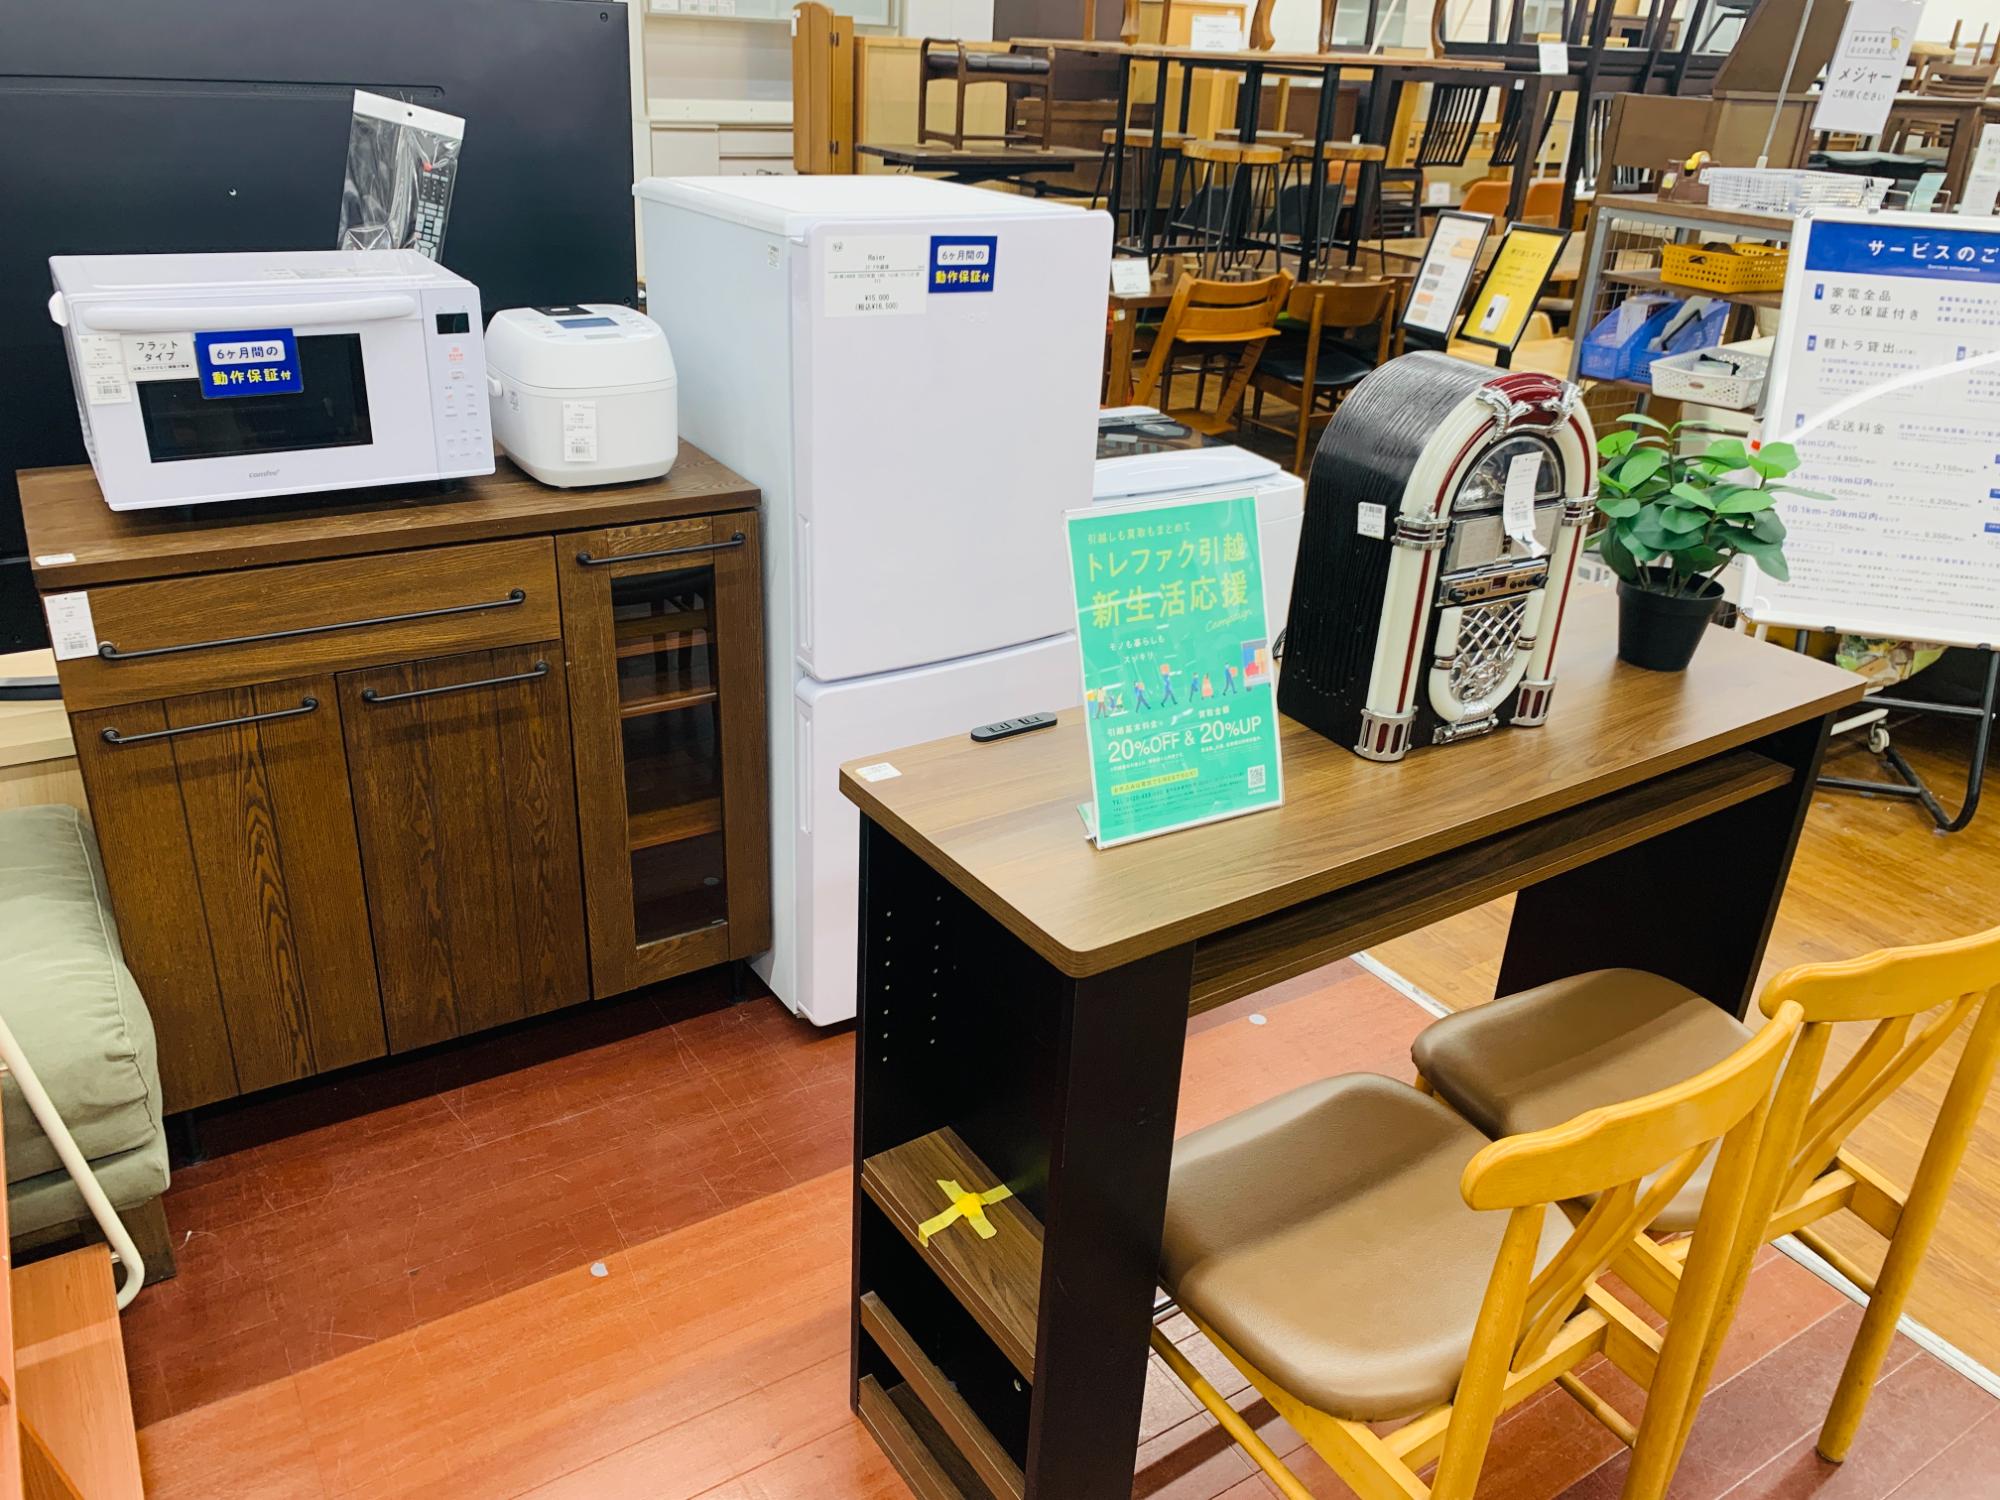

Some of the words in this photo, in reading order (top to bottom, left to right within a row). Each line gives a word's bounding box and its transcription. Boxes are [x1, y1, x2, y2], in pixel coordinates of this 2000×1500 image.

[1838, 66, 1892, 84] メジャー
[1831, 88, 1886, 101] ご利用ください
[941, 249, 985, 262] 6ヶ月間の
[1868, 240, 1999, 263] サービスのご
[935, 269, 989, 284] 動作保証付
[1831, 287, 1892, 302] 家電全品
[1829, 304, 1920, 321] 安心保証付き
[136, 340, 179, 352] フラット
[216, 344, 279, 360] 6ヶ月間の
[1823, 337, 1895, 353] 軽トラ貸出
[144, 352, 176, 362] タイプ
[211, 368, 292, 386] 動作保証付
[1818, 419, 1886, 435] 配送料金
[1087, 522, 1192, 545] 引越しも買取もまとめて
[1088, 532, 1247, 582] トレファク引越
[1092, 570, 1248, 629] 新生活応援
[1107, 732, 1181, 763] 20%OFF
[1184, 729, 1196, 747] &
[1199, 715, 1262, 744] 20%UP
